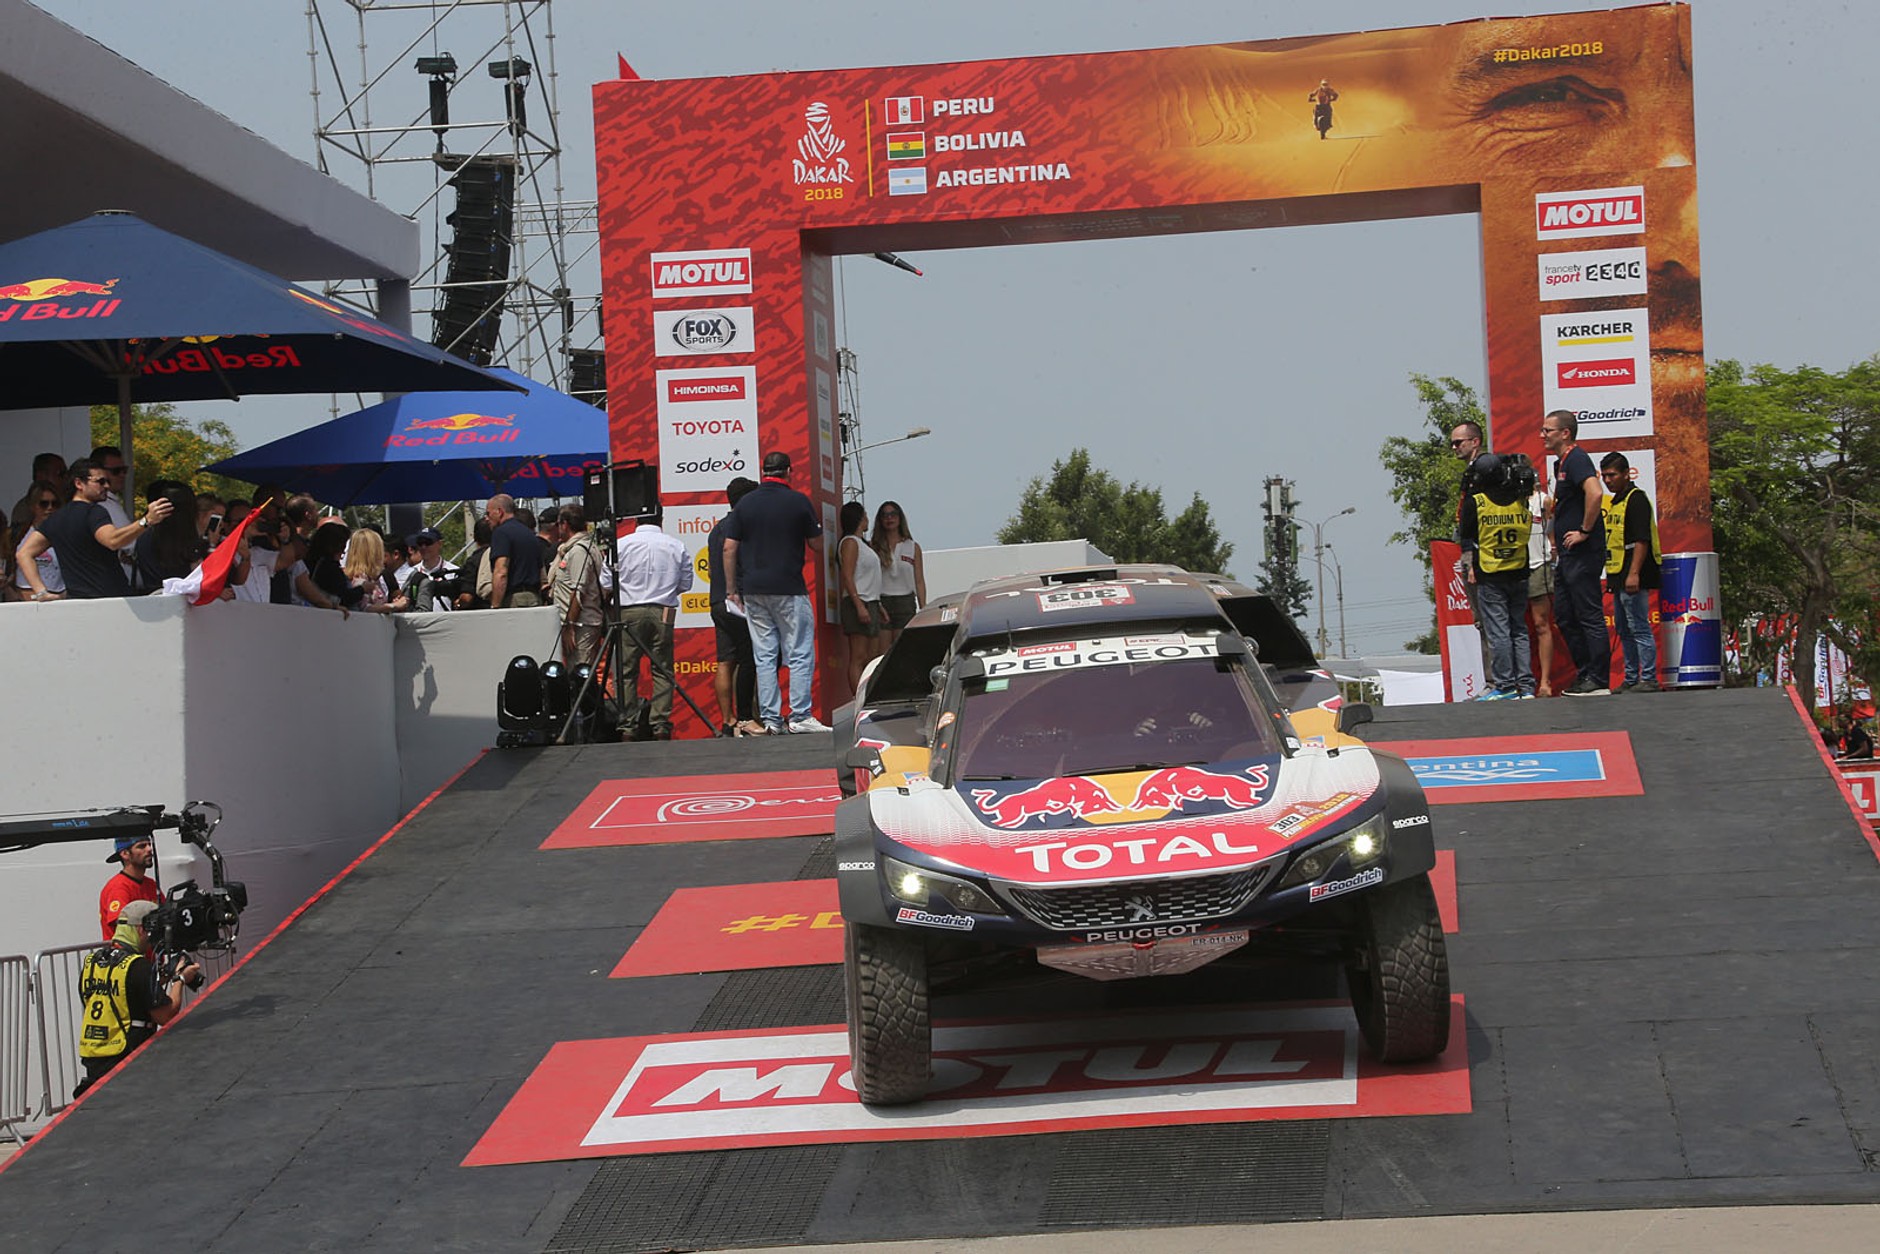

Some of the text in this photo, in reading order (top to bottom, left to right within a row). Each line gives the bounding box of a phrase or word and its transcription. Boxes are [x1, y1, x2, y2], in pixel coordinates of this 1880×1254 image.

[1493, 41, 1604, 63] #Dakar2018
[932, 96, 995, 117] PERU
[934, 130, 1026, 153] BOLIVIA
[792, 157, 854, 186] DAKAR
[935, 162, 1071, 188] ARGENTINA
[804, 187, 844, 201] 2018
[1543, 199, 1638, 227] MOTUL
[657, 260, 746, 285] MOTUL
[1545, 271, 1582, 286] sport
[20, 298, 123, 321] Bull
[684, 318, 724, 338] FOX
[1557, 321, 1634, 338] KÄRCHER
[685, 335, 724, 345] SPORTS
[1578, 367, 1631, 379] HONDA
[673, 383, 740, 396] HIMOINSA
[1570, 406, 1647, 422] Goodrich
[672, 418, 745, 437] TOYOTA
[382, 428, 522, 449] Red Bull
[674, 455, 746, 474] sodexo
[1481, 513, 1529, 526] PODIUM TV
[1493, 528, 1519, 546] 16
[1661, 596, 1714, 614] Red Bull
[1022, 642, 1072, 655] MOTUL
[988, 643, 1216, 676] PEUGEOT
[1273, 815, 1301, 830] 303
[1392, 815, 1430, 829] sparco
[1014, 832, 1259, 874] TOTAL
[838, 861, 875, 871] sparco
[1311, 868, 1383, 898] BFGoodrich
[182, 908, 193, 927] 3
[898, 909, 974, 927] BFGoodrich
[1086, 923, 1202, 943] PEUGEOT
[90, 1000, 104, 1021] 8
